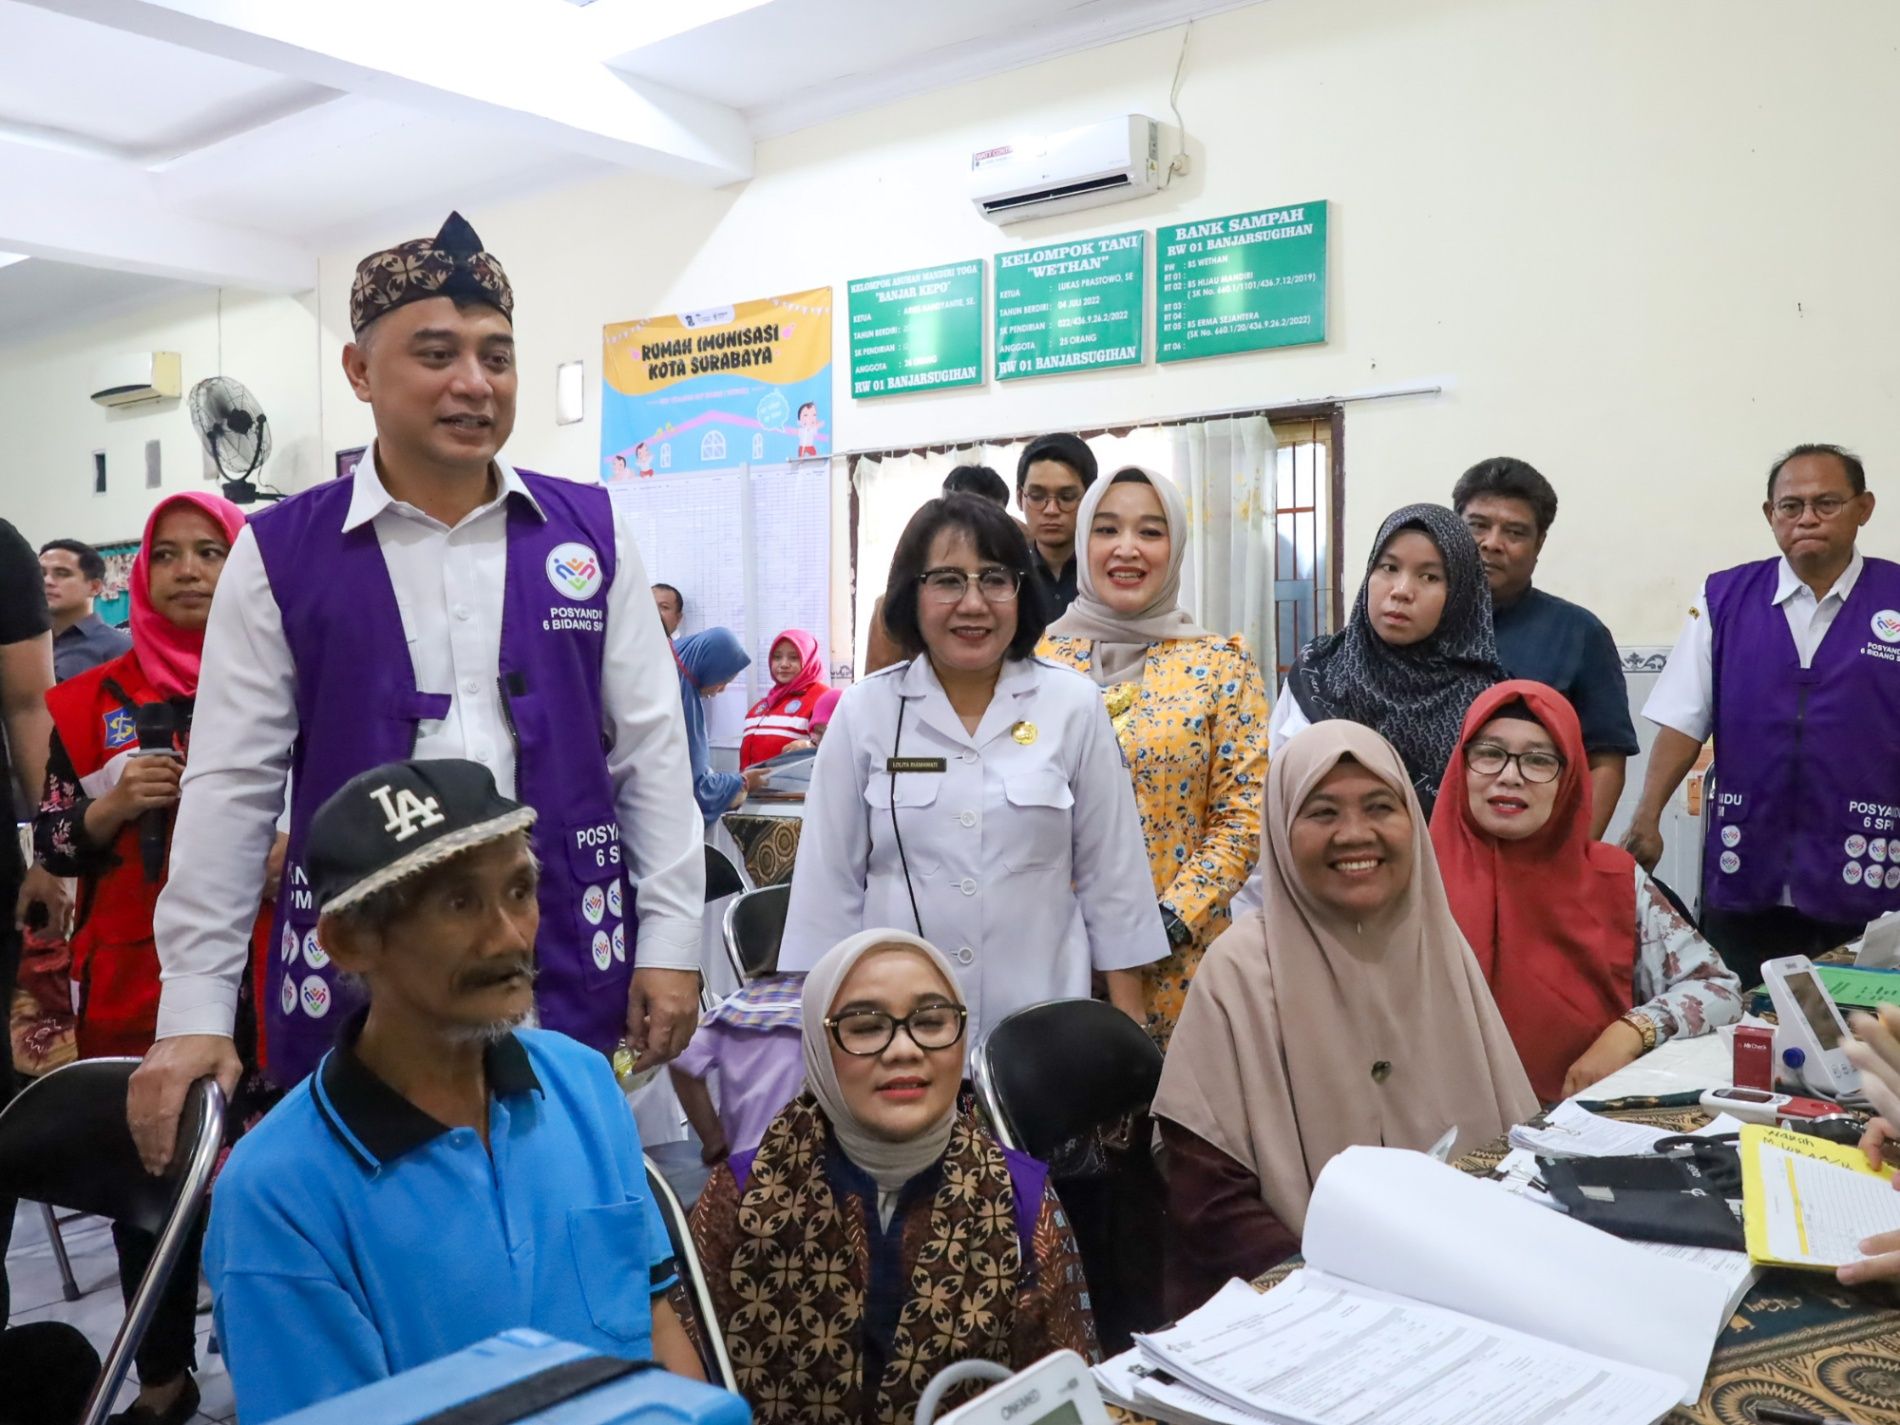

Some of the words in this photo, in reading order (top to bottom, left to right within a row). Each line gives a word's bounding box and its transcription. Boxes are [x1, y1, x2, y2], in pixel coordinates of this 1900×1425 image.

[1175, 222, 1224, 241] BANK
[1228, 208, 1304, 232] SAMPAH
[1001, 242, 1094, 268] KELOMPOK
[1099, 235, 1138, 252] TANI
[1167, 245, 1187, 256] RW
[1190, 243, 1203, 253] 01
[1207, 224, 1313, 250] BANJARSUGIHAN
[1028, 256, 1109, 278] "WETHAN"
[1058, 282, 1080, 291] LUKAS
[1000, 307, 1022, 317] TAHUN
[642, 337, 692, 361] RUMAH
[697, 323, 779, 352] IMUNISASI
[1000, 342, 1035, 353] ANGGOTA
[1070, 334, 1097, 345] ORANG
[649, 360, 686, 380] KOTA
[691, 346, 772, 374] SURABAYA
[999, 361, 1017, 374] RW
[1020, 360, 1032, 372] 01
[1036, 346, 1136, 370] BANJARSUGIHAN
[855, 381, 870, 393] RW
[873, 380, 884, 391] 01
[888, 366, 976, 389] BANJARSUGIHAN
[543, 620, 550, 630] 6
[552, 619, 591, 631] BIDANG
[370, 785, 445, 841] LA
[1863, 817, 1871, 828] 6
[596, 848, 605, 867] 6
